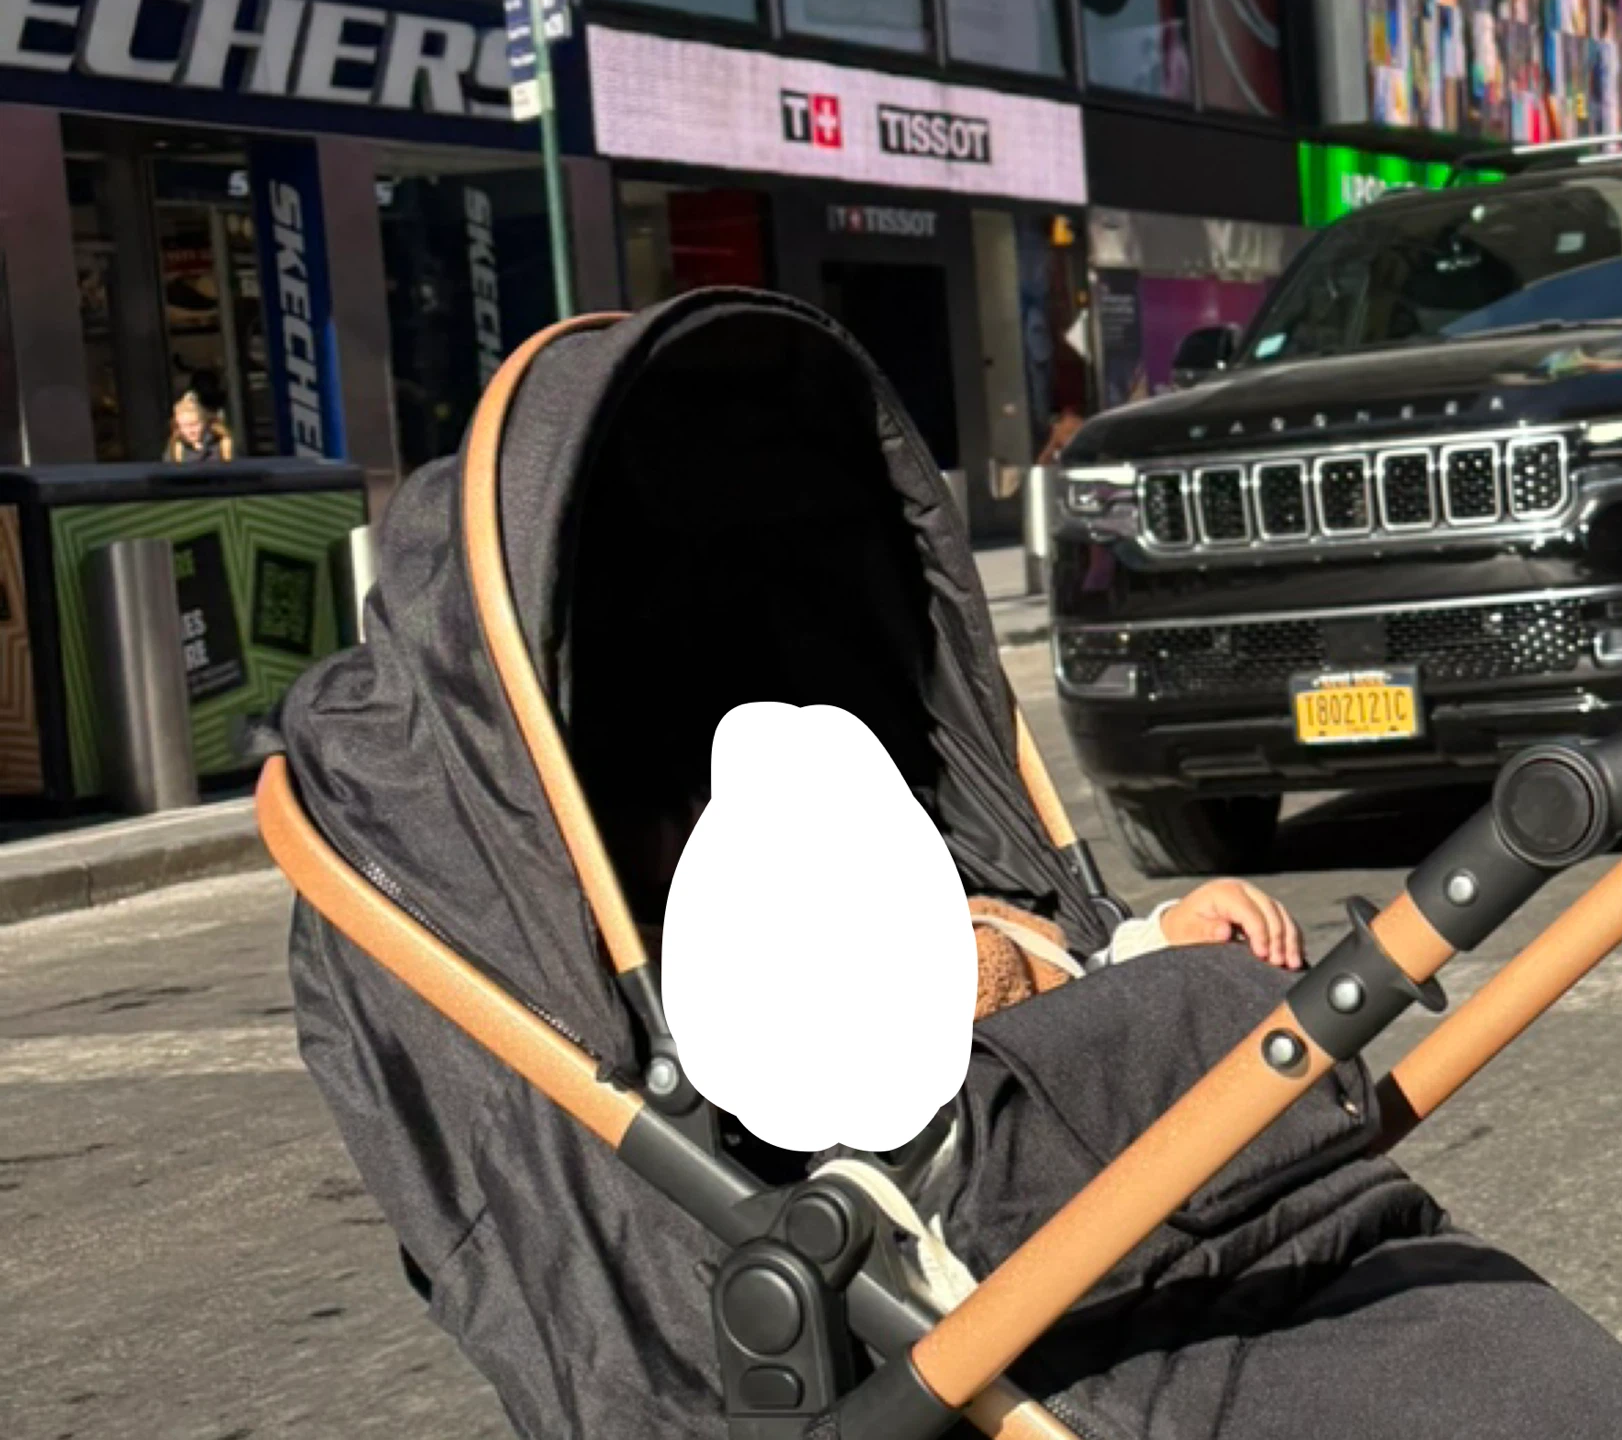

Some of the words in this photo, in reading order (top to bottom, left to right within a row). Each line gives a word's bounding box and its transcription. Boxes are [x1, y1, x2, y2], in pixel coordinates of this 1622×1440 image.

[881, 110, 989, 161] TISSOT
[863, 207, 938, 237] TISSOT
[269, 179, 323, 462] SKECHE
[1304, 690, 1408, 727] T802121C
